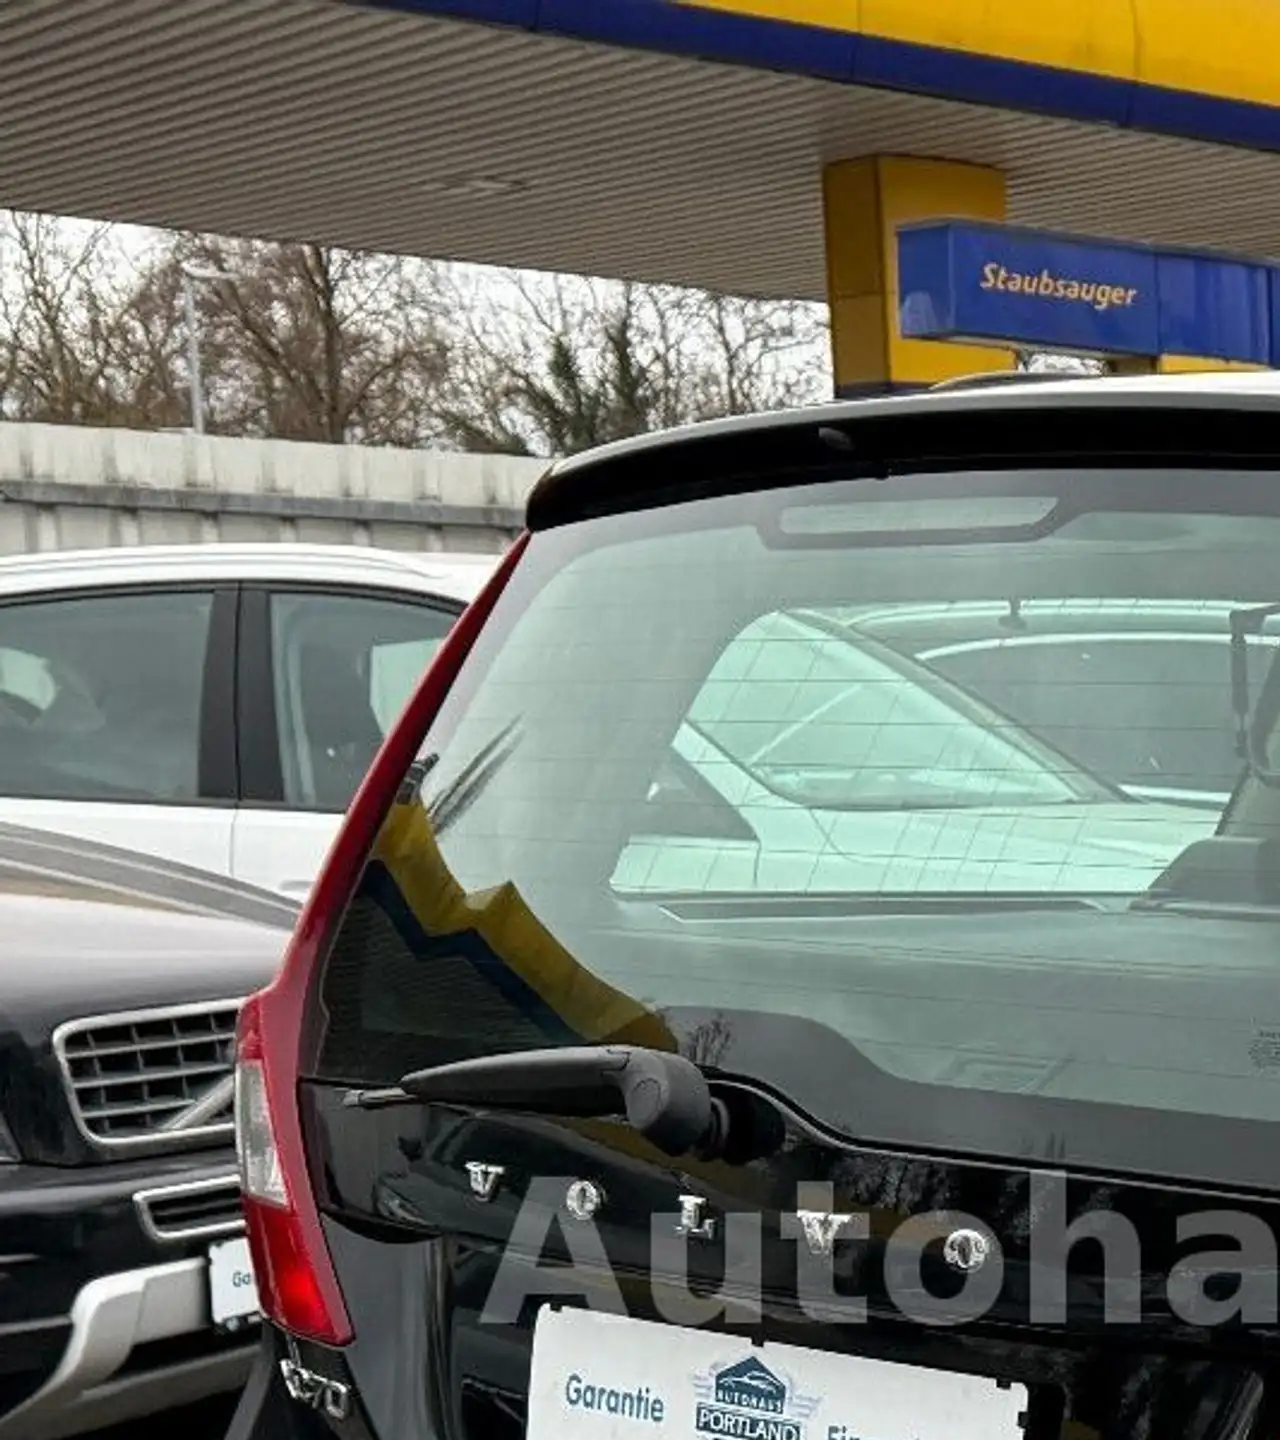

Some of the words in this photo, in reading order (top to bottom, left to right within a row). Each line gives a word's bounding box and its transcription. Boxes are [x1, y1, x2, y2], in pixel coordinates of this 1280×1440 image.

[980, 262, 1137, 311] Staubsauger
[465, 1160, 991, 1272] VOLVO
[566, 1373, 664, 1422] Garantie
